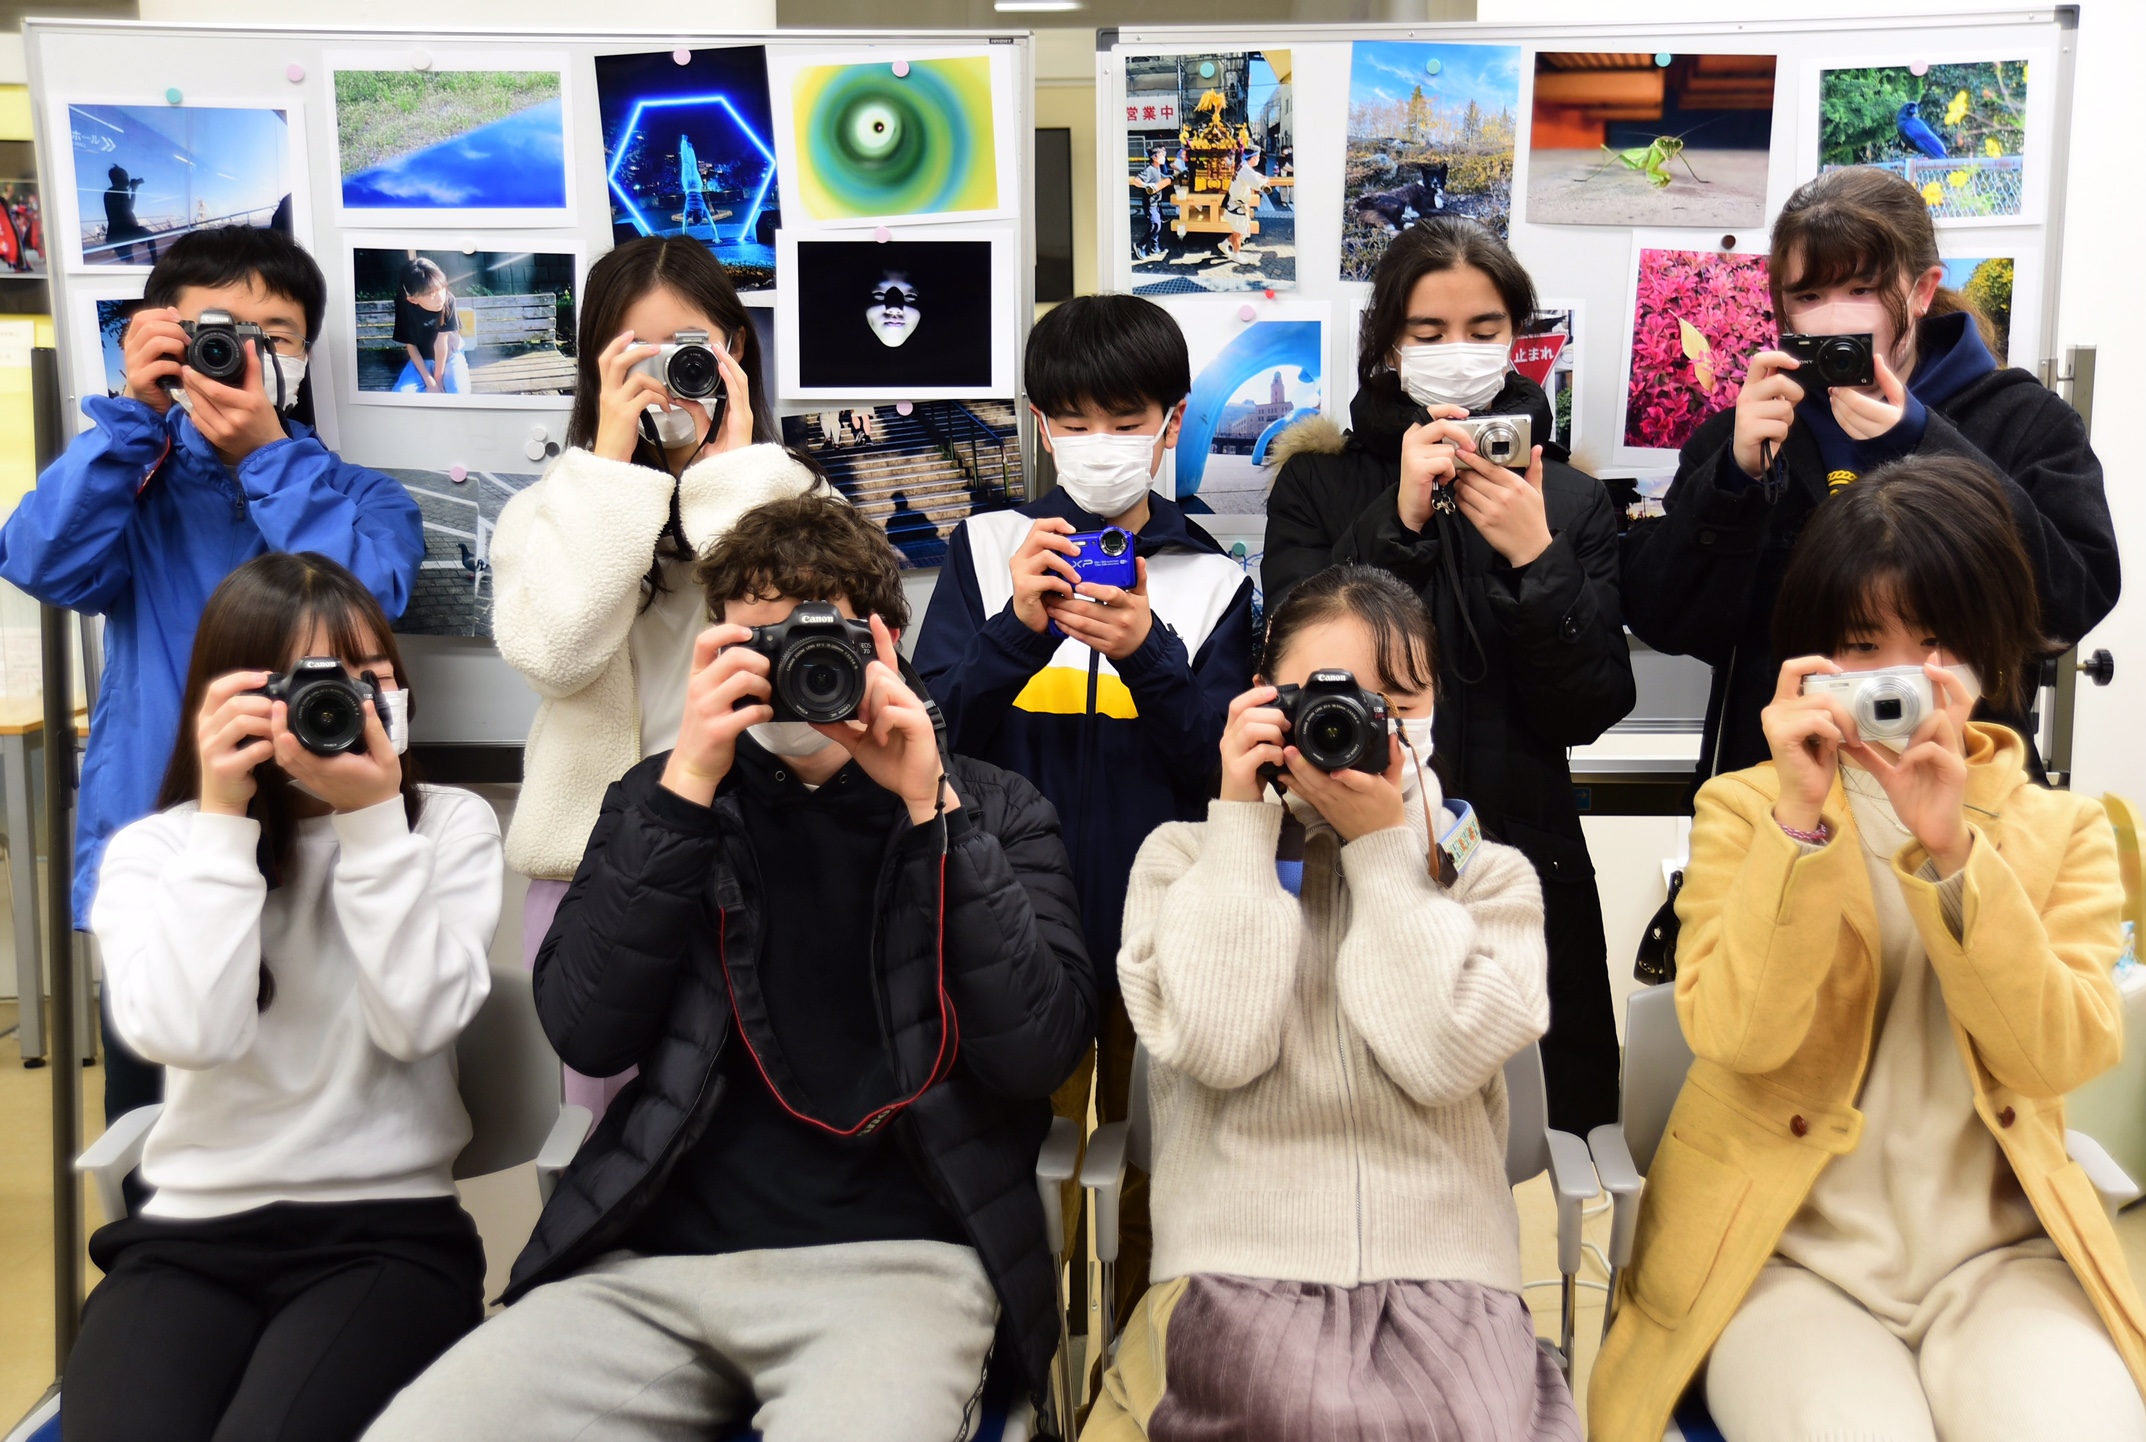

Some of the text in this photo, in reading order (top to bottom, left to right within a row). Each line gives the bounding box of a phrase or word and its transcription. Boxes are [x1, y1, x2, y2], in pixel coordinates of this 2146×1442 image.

[1126, 104, 1174, 121] 営業中
[71, 130, 100, 145] ホール
[204, 315, 229, 323] Canon
[1513, 345, 1554, 363] 止まれ
[1072, 559, 1094, 569] XP
[802, 615, 834, 623] Canon
[1318, 674, 1346, 682] Canon
